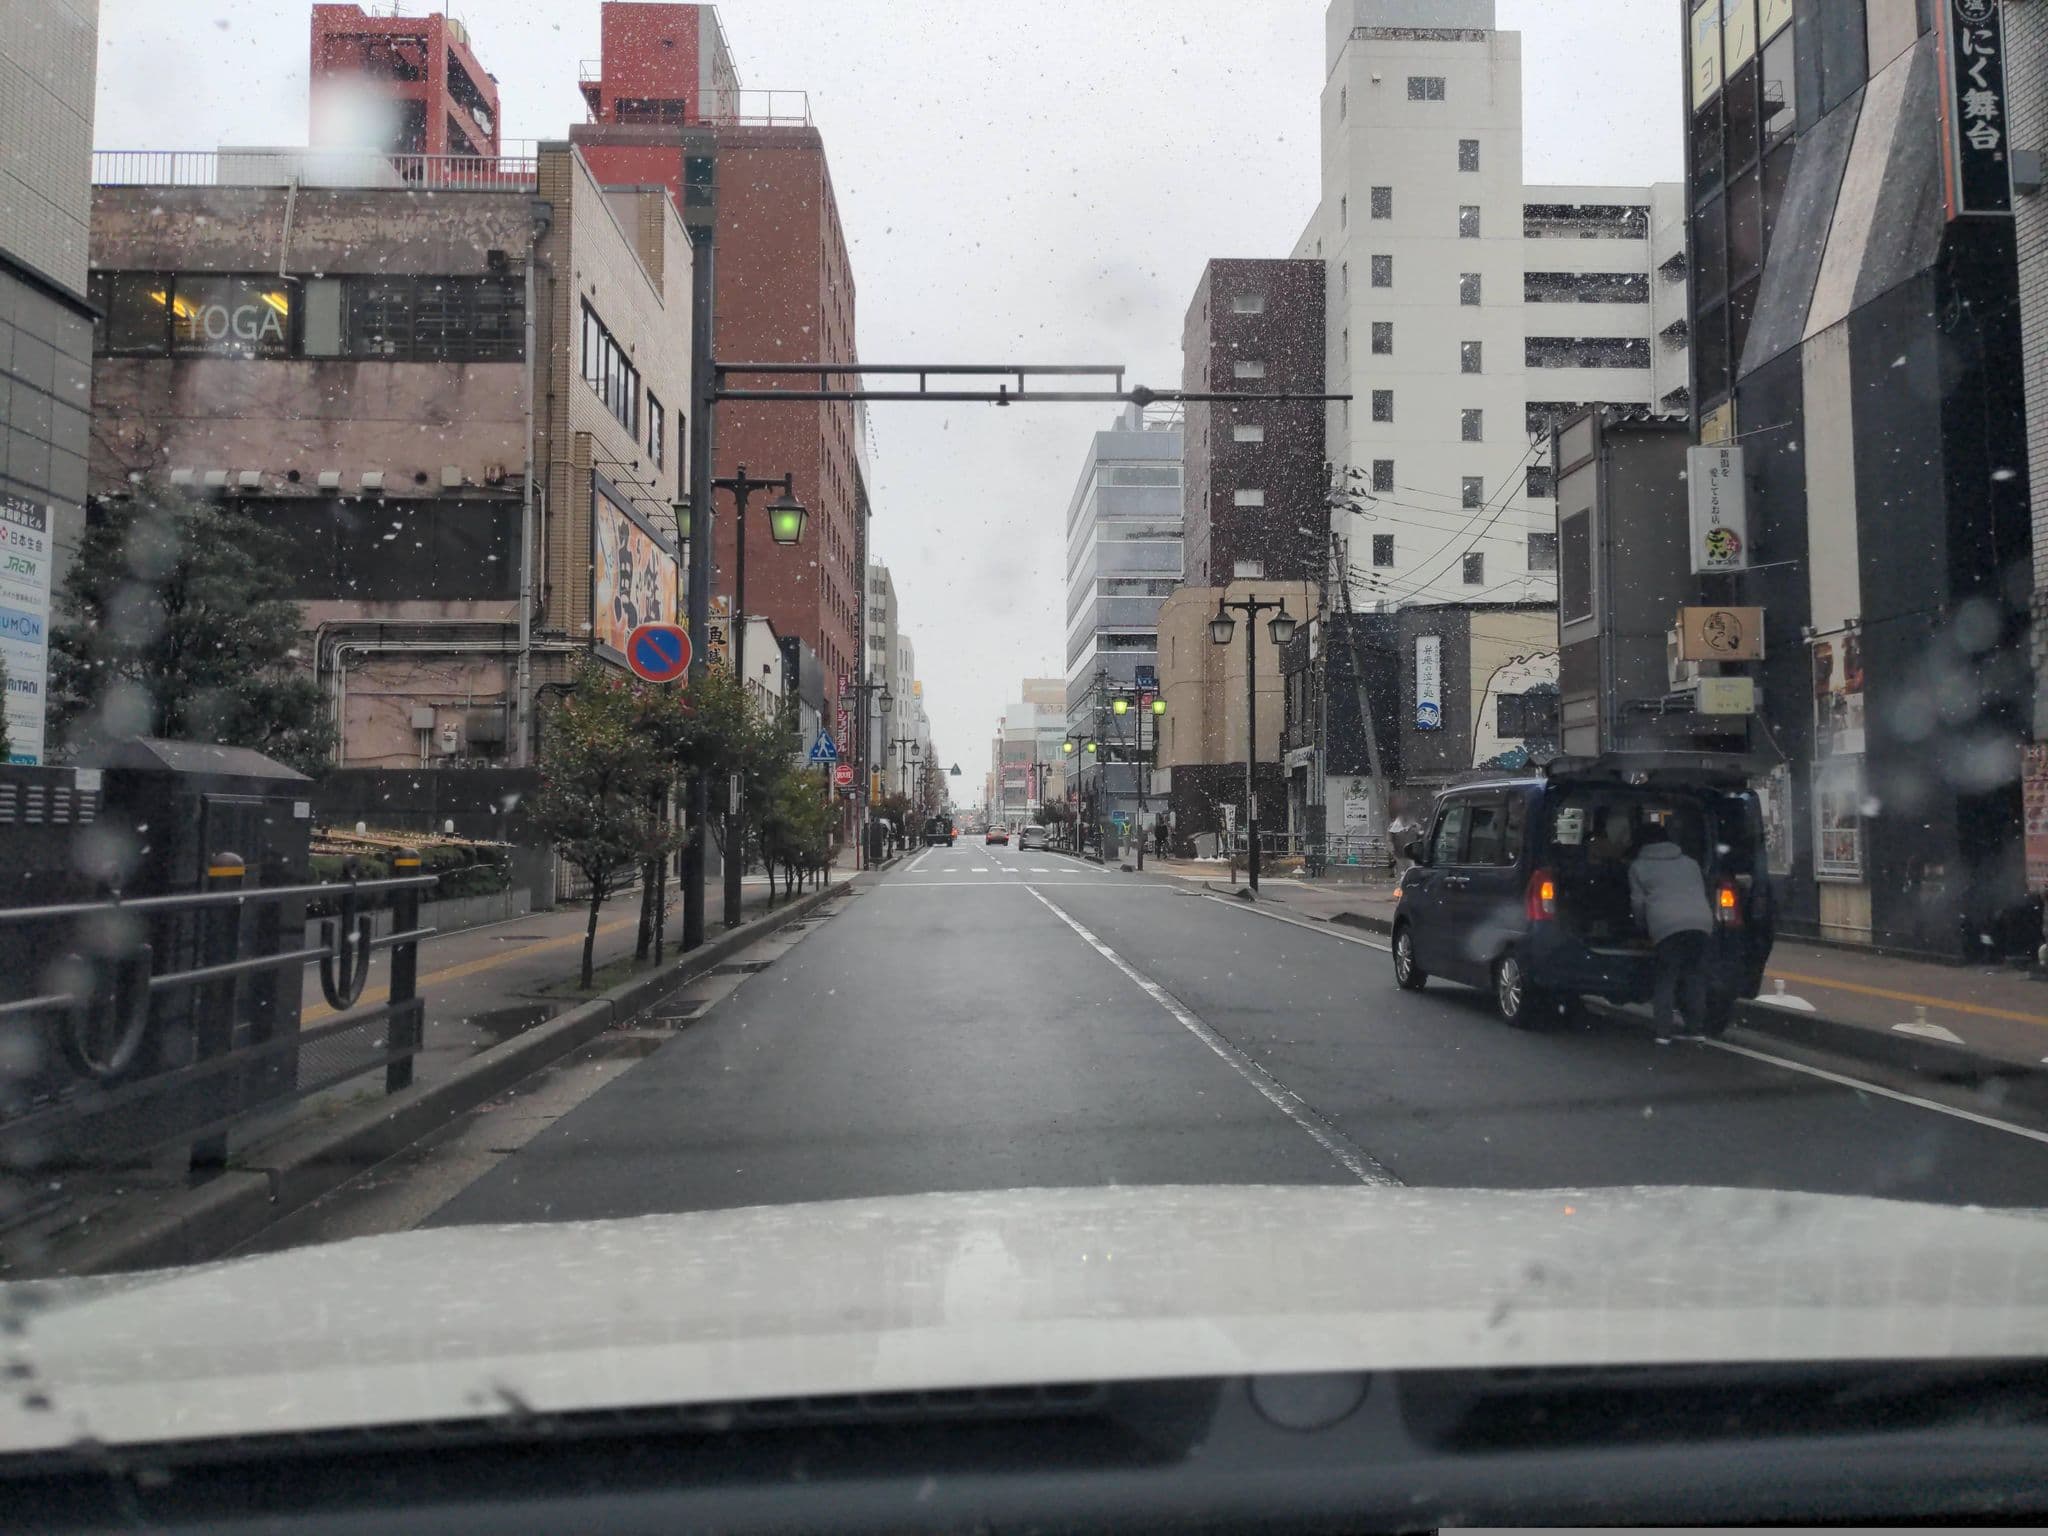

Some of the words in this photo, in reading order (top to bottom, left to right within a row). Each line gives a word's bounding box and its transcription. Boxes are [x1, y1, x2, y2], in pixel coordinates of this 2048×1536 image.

[1961, 28, 2000, 151] にく舞台
[184, 304, 284, 341] YOGA
[7, 497, 35, 514] ニッセイ
[0, 615, 39, 636] UMON
